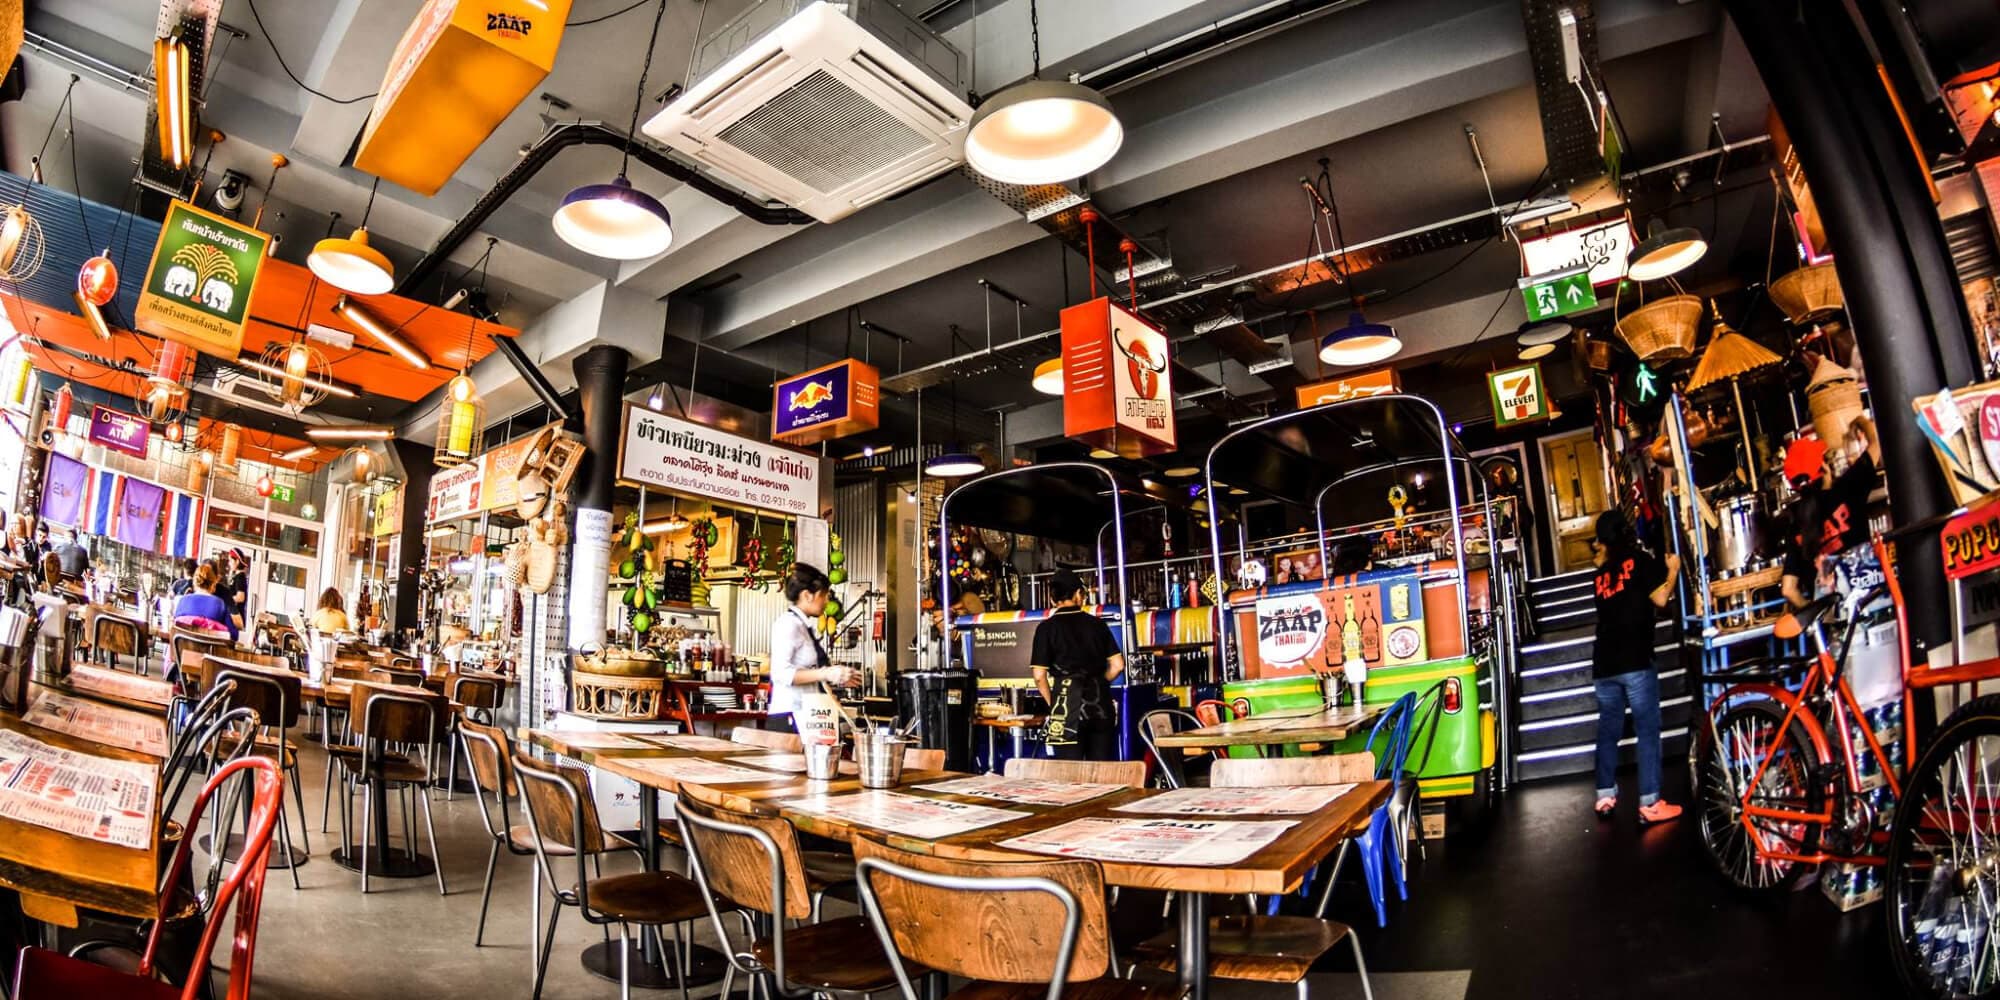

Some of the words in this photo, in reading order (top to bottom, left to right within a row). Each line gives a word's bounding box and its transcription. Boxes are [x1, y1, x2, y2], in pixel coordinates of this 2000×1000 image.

[487, 13, 532, 36] ZAAP
[637, 417, 761, 468] ข้าวเหนียวมะม่วง
[761, 494, 806, 511] 02-931-9889
[987, 631, 1017, 640] SINGHA
[1260, 609, 1322, 641] ZAAP
